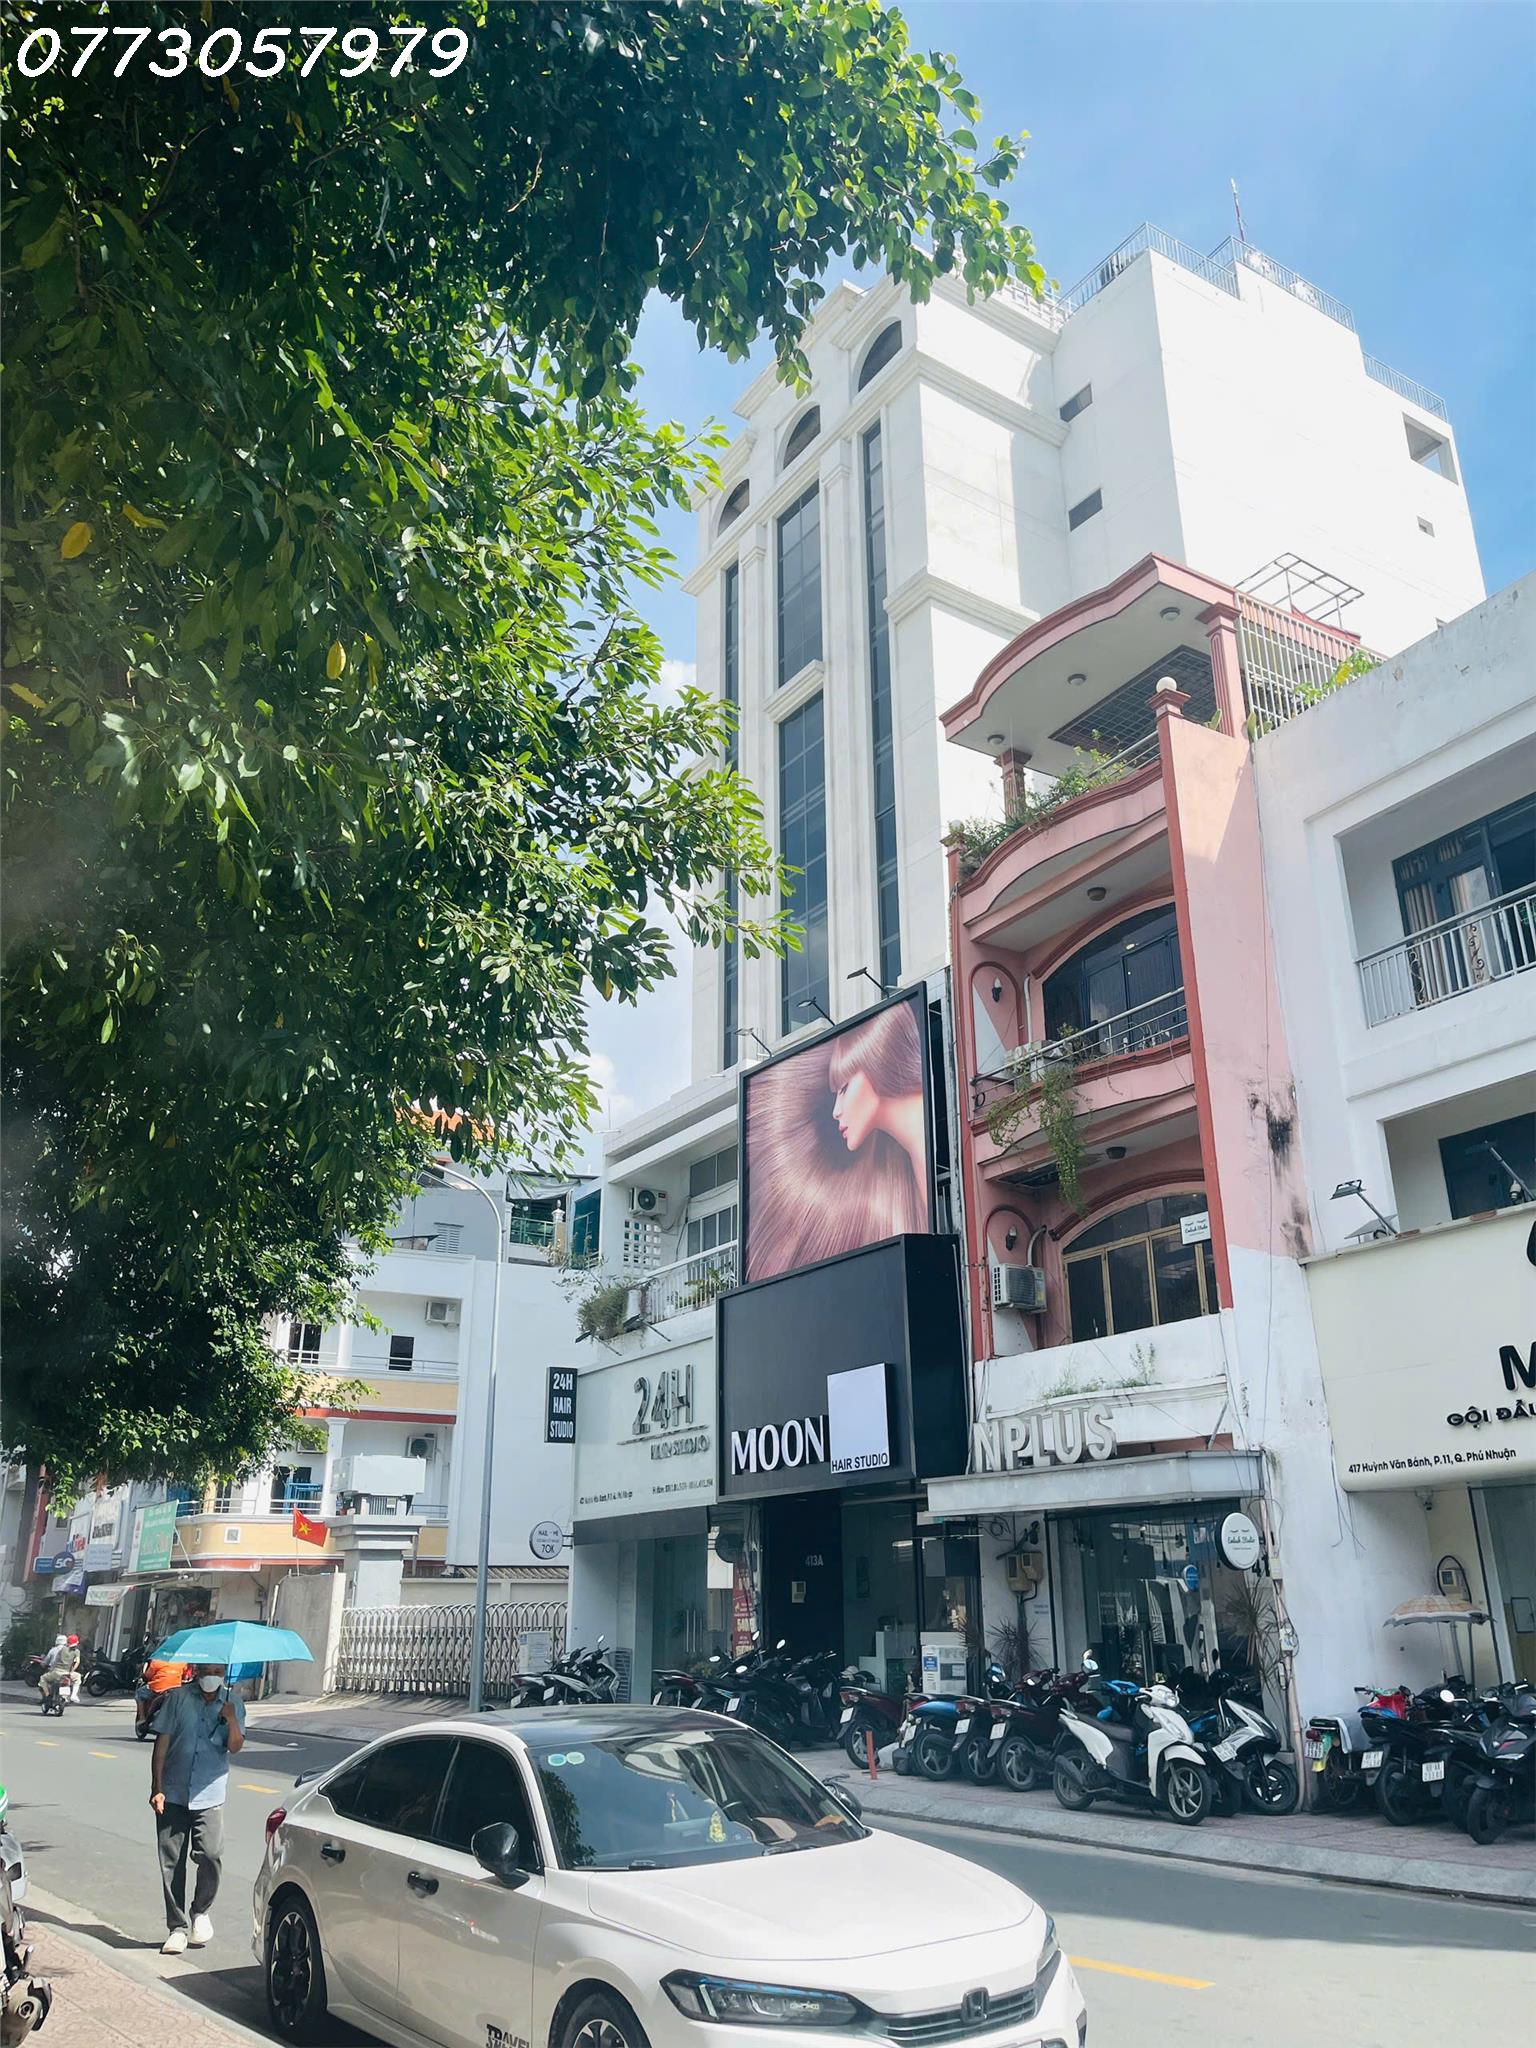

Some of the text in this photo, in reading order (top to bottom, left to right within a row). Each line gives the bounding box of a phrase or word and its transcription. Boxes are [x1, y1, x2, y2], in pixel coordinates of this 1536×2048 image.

[552, 1373, 574, 1390] 24H
[553, 1397, 572, 1414] HAIR
[632, 1364, 694, 1435] 24H
[1447, 1405, 1491, 1428] GỘI
[550, 1420, 574, 1438] STUDIO
[973, 1403, 1117, 1473] NPLUS
[731, 1415, 825, 1475] MOON
[832, 1453, 889, 1472] HAIR STUDIO
[1348, 1463, 1361, 1473] 417
[1362, 1460, 1389, 1473] Huỳnh
[1389, 1459, 1407, 1469] Văn
[1454, 1453, 1466, 1463] Q.
[1466, 1450, 1485, 1462] Phú
[1485, 1447, 1517, 1461] Nhuận
